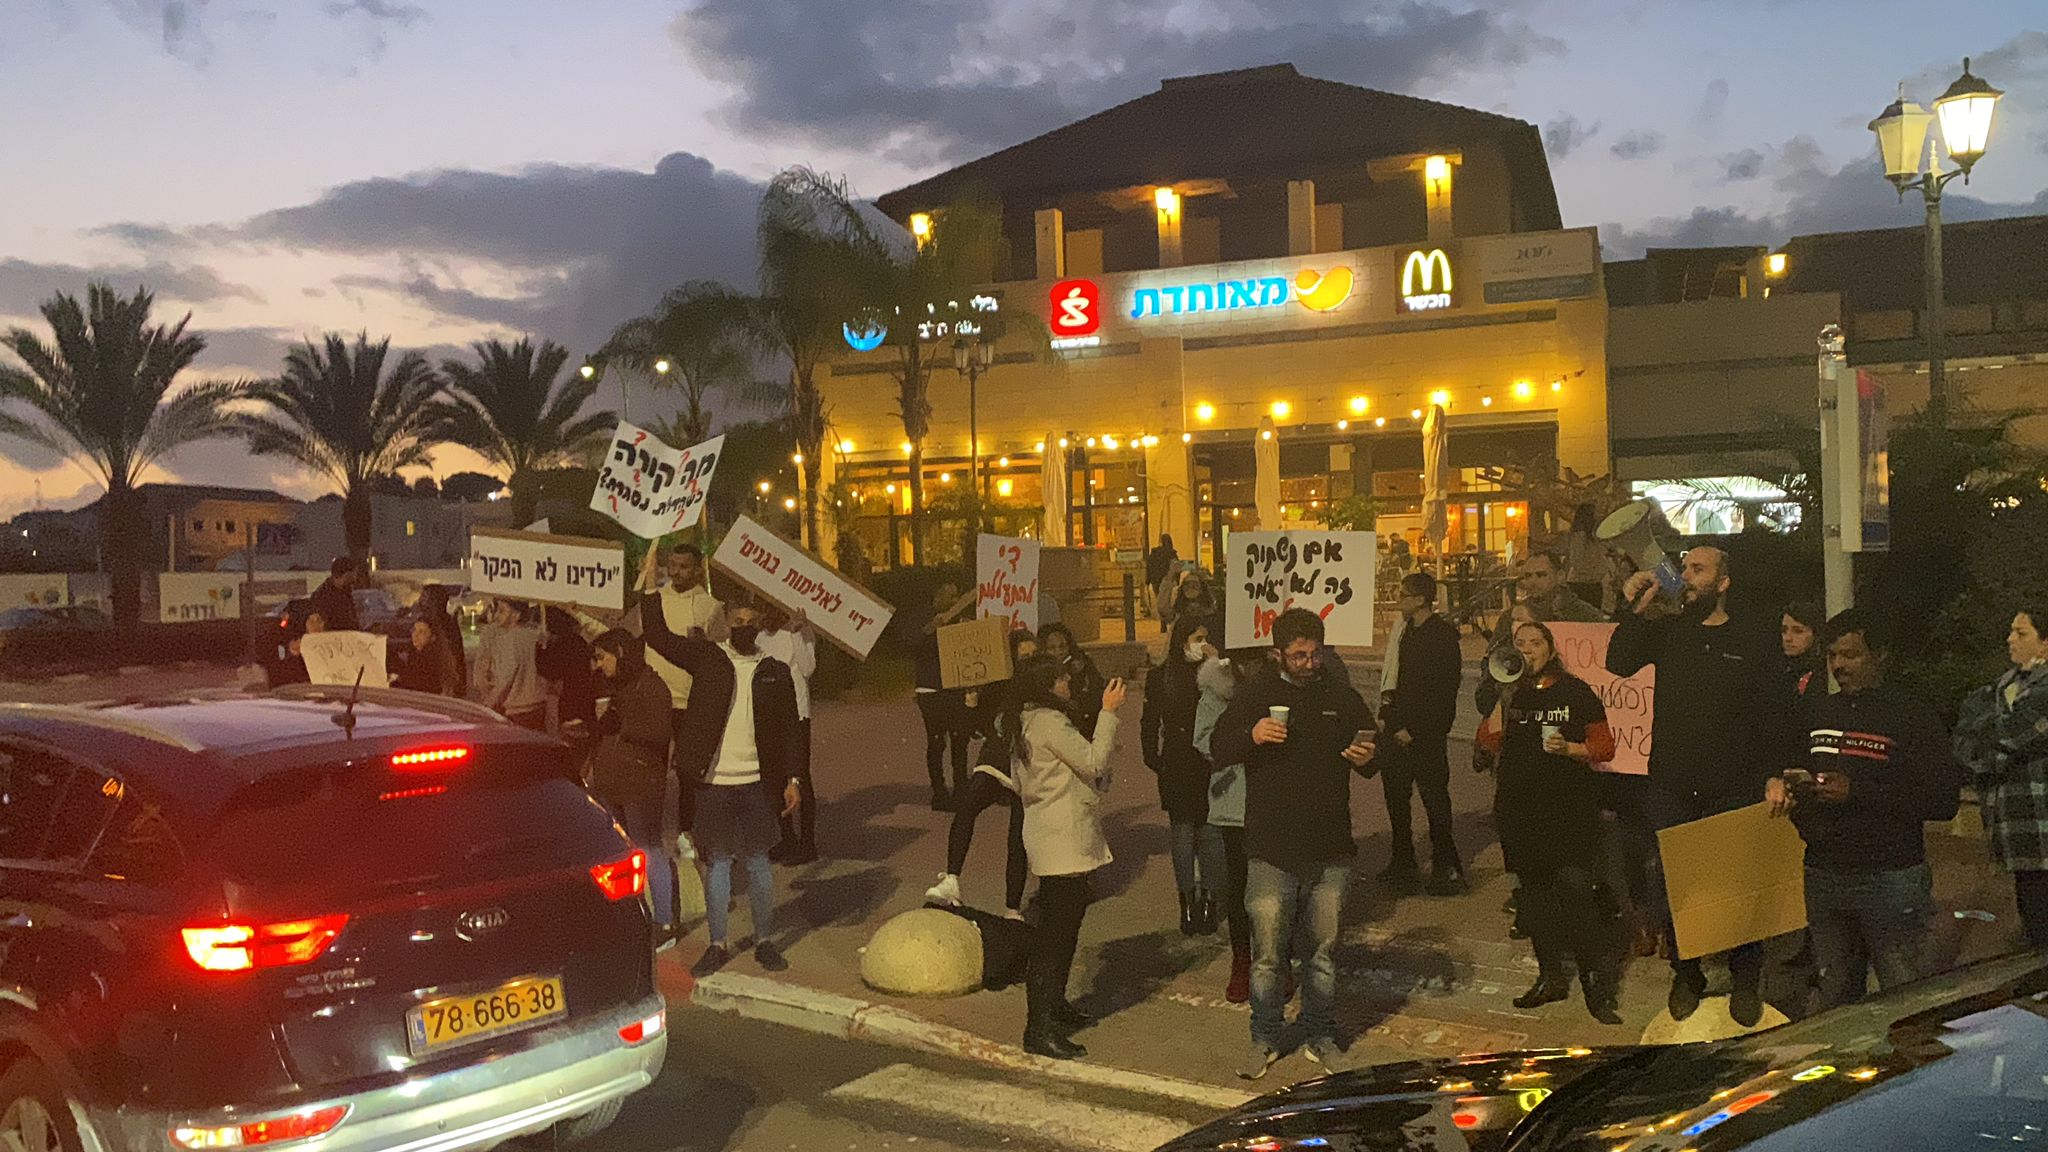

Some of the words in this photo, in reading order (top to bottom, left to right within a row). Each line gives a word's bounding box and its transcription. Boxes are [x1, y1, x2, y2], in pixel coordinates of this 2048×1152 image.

[1131, 277, 1289, 318] מאוחדת
[614, 440, 675, 493] קורה
[680, 453, 715, 490] מה
[998, 545, 1021, 574] די
[1246, 536, 1297, 578] נשתוק
[1303, 539, 1343, 564] אם
[536, 556, 557, 582] לא
[1290, 568, 1321, 595] לא
[782, 568, 842, 613] לאלימות
[1324, 577, 1353, 605] זה
[1845, 740, 1885, 750] HILFIGER
